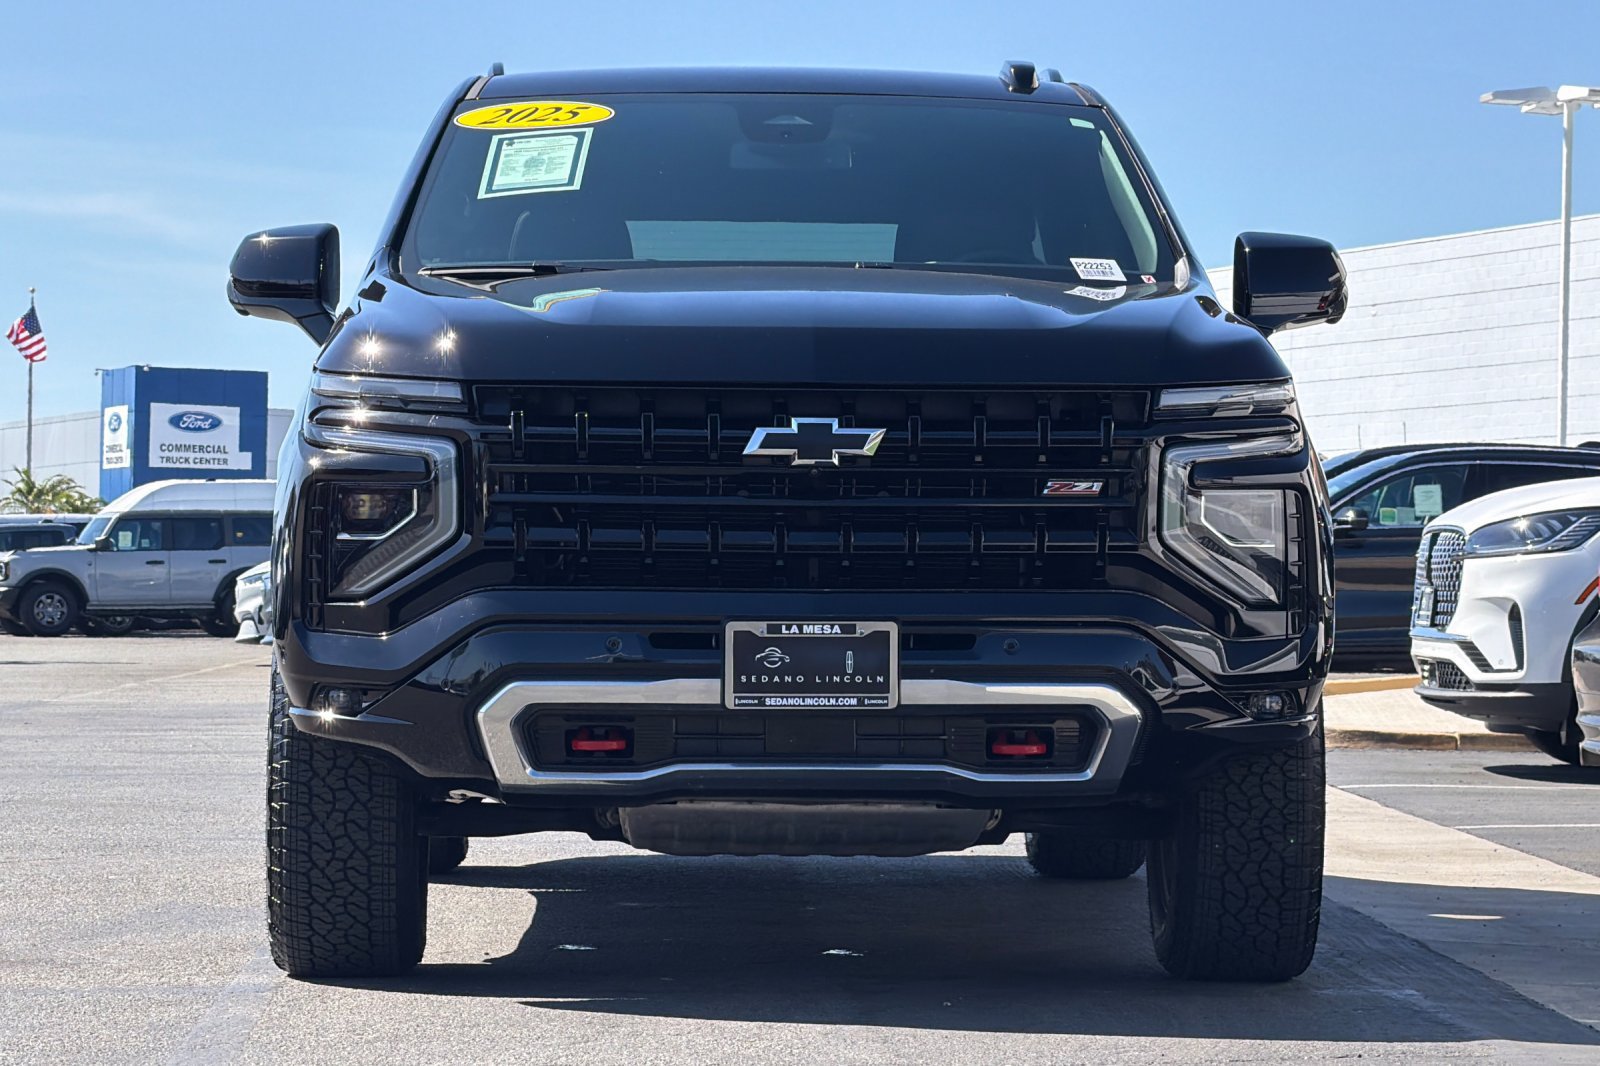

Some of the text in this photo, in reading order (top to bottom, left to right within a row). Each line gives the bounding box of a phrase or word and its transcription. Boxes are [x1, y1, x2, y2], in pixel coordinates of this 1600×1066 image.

[478, 106, 592, 125] 2025
[1075, 261, 1113, 271] P22253
[179, 414, 213, 430] Ford
[159, 443, 229, 454] COMMERCIAL
[160, 456, 229, 466] TRUCK CENTER
[781, 624, 841, 634] LA MESA
[741, 675, 884, 683] SEDANO LINCOLN
[765, 697, 858, 706] SEDANOLINCOLN.COM
